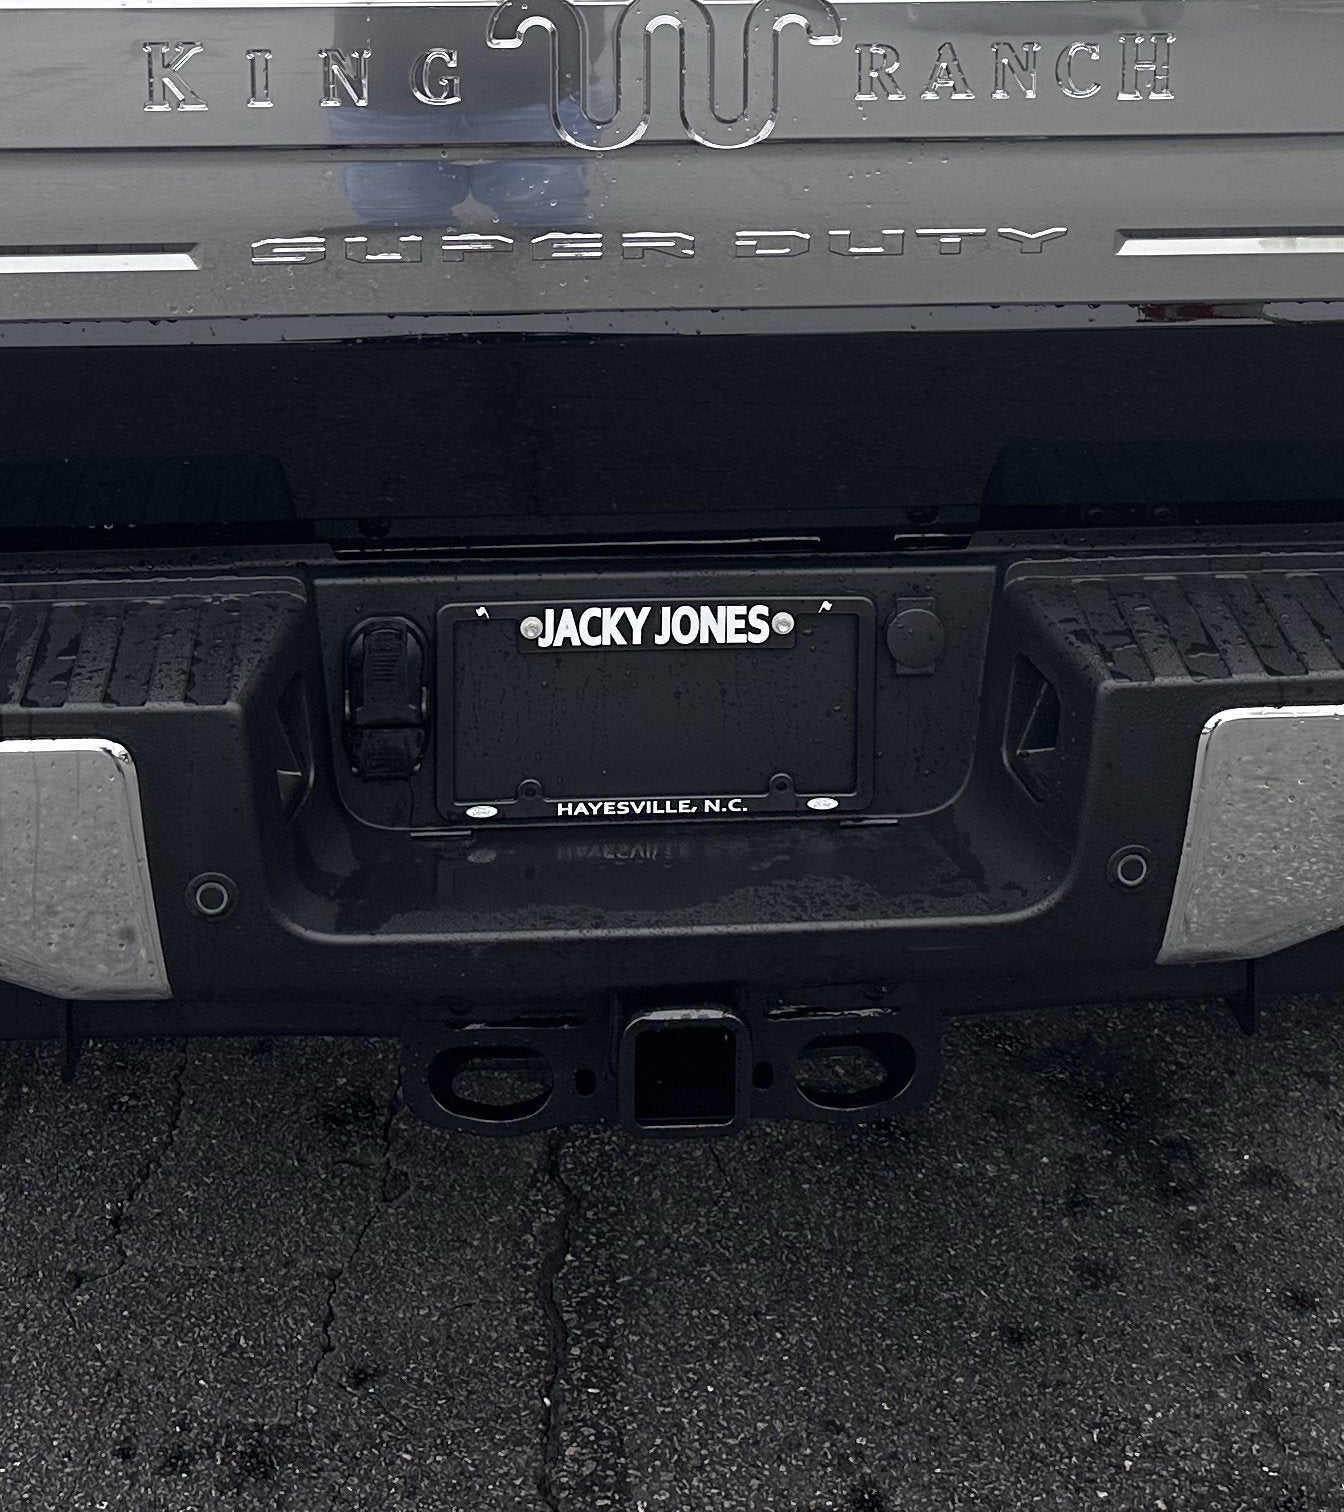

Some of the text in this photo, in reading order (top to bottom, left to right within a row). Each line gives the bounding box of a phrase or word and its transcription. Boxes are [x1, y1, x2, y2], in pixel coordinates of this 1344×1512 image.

[142, 32, 1177, 112] KING RANCH
[252, 228, 1067, 264] SUPER DUTY
[538, 605, 770, 648] JACKY JONES
[557, 798, 748, 816] HAYESVILLE, N.C.
